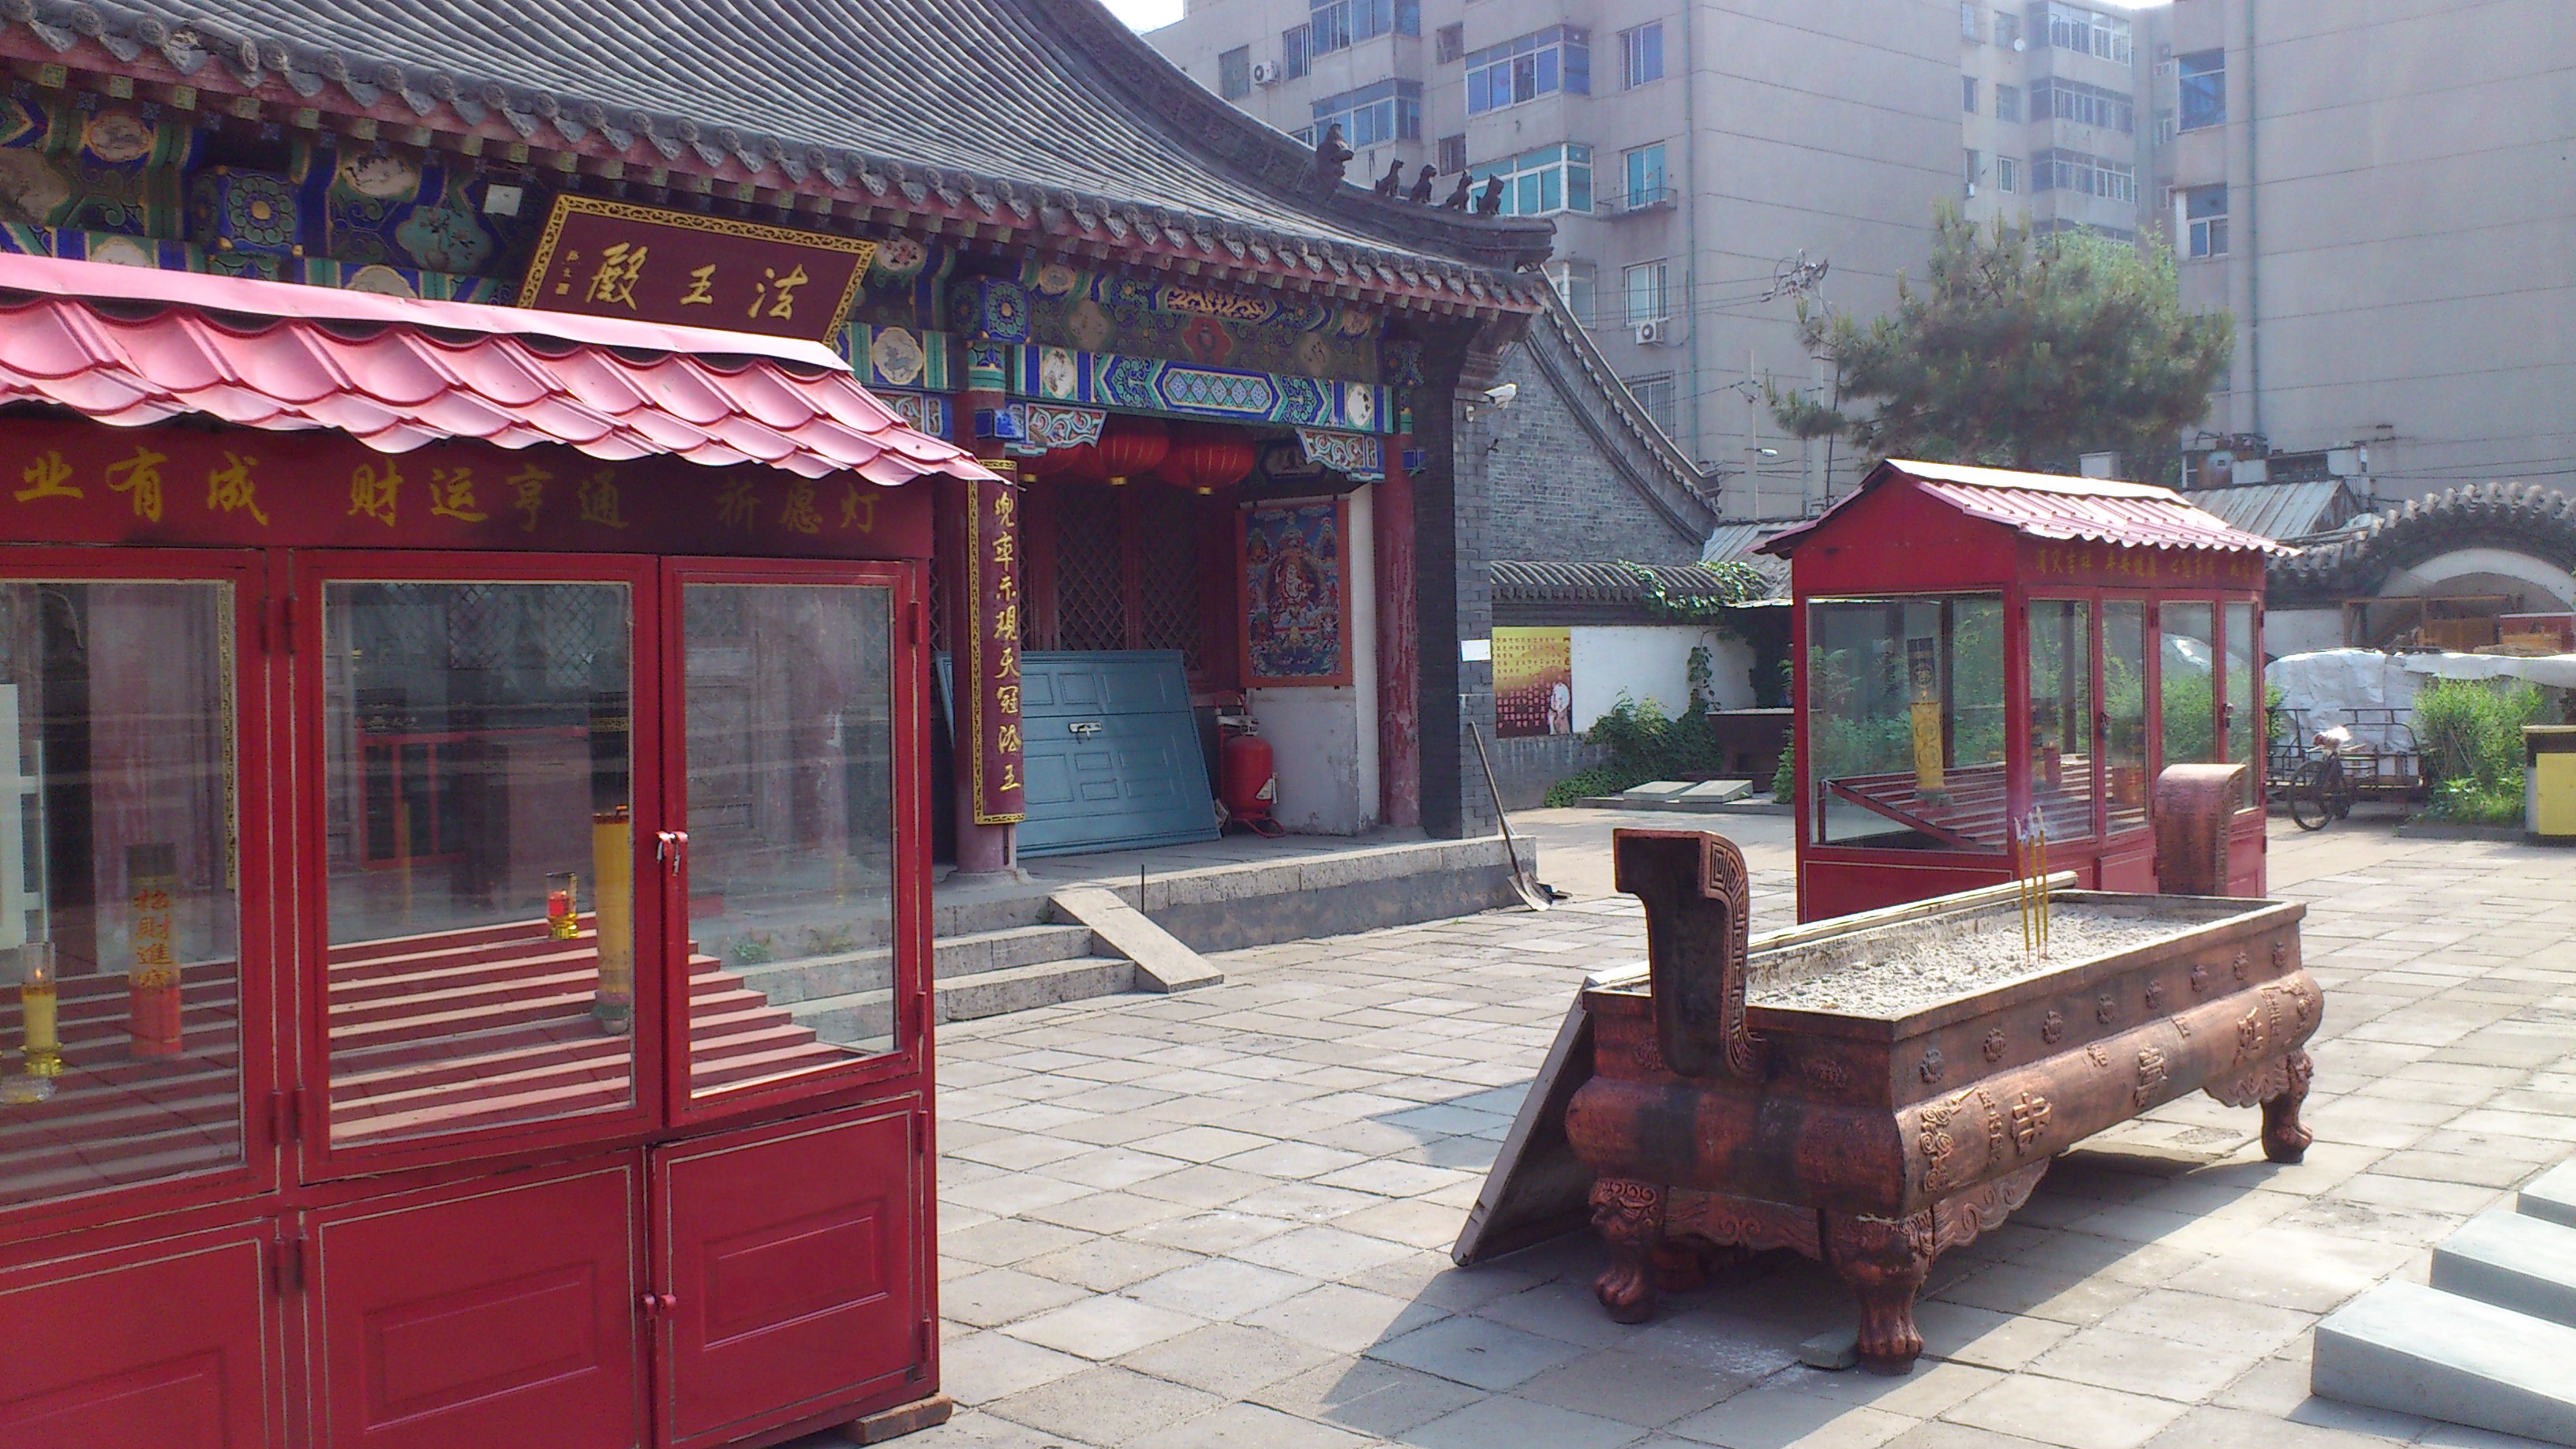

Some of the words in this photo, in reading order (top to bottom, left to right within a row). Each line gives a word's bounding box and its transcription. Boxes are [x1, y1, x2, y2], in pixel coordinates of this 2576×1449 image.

[13, 444, 268, 526] 业有成
[347, 455, 629, 534] 财运亨通
[716, 474, 881, 534] 祈愿灯
